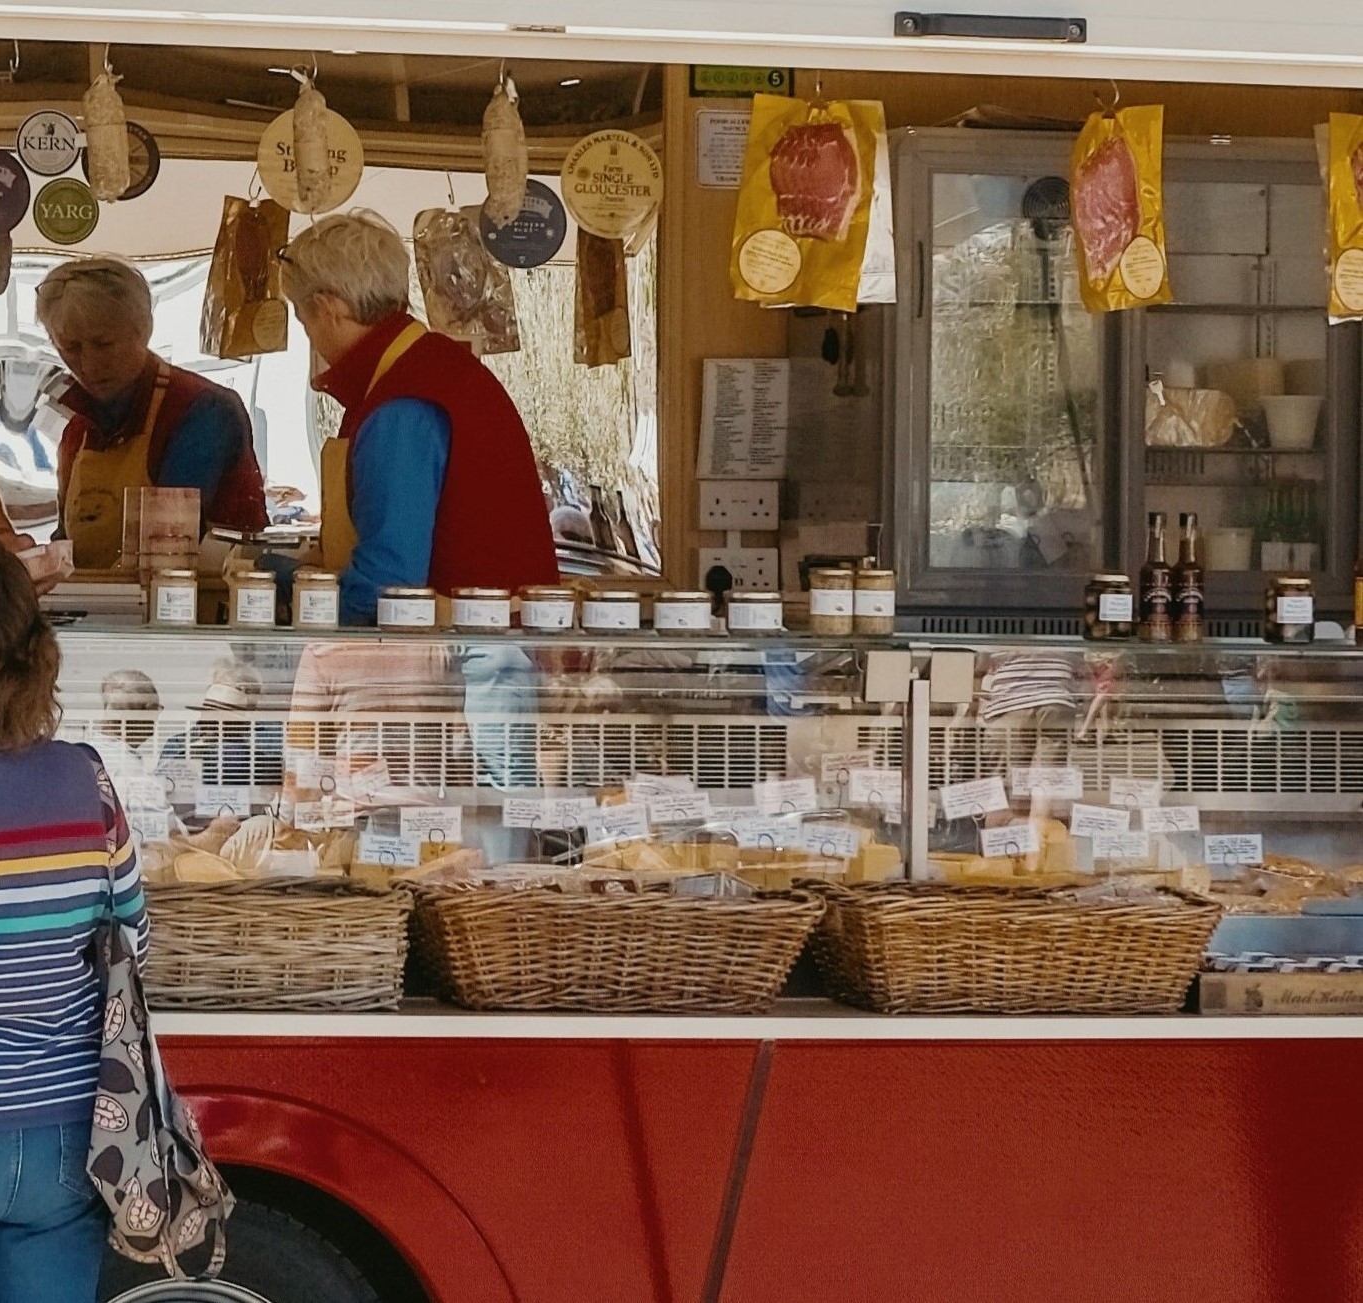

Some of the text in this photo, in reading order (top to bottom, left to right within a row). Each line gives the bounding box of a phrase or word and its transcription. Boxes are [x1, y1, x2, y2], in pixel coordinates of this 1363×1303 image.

[772, 72, 781, 86] 5
[23, 136, 76, 151] KERN
[593, 172, 634, 184] SINGLE
[574, 183, 651, 197] GLOUCESTER
[41, 203, 93, 219] YARG
